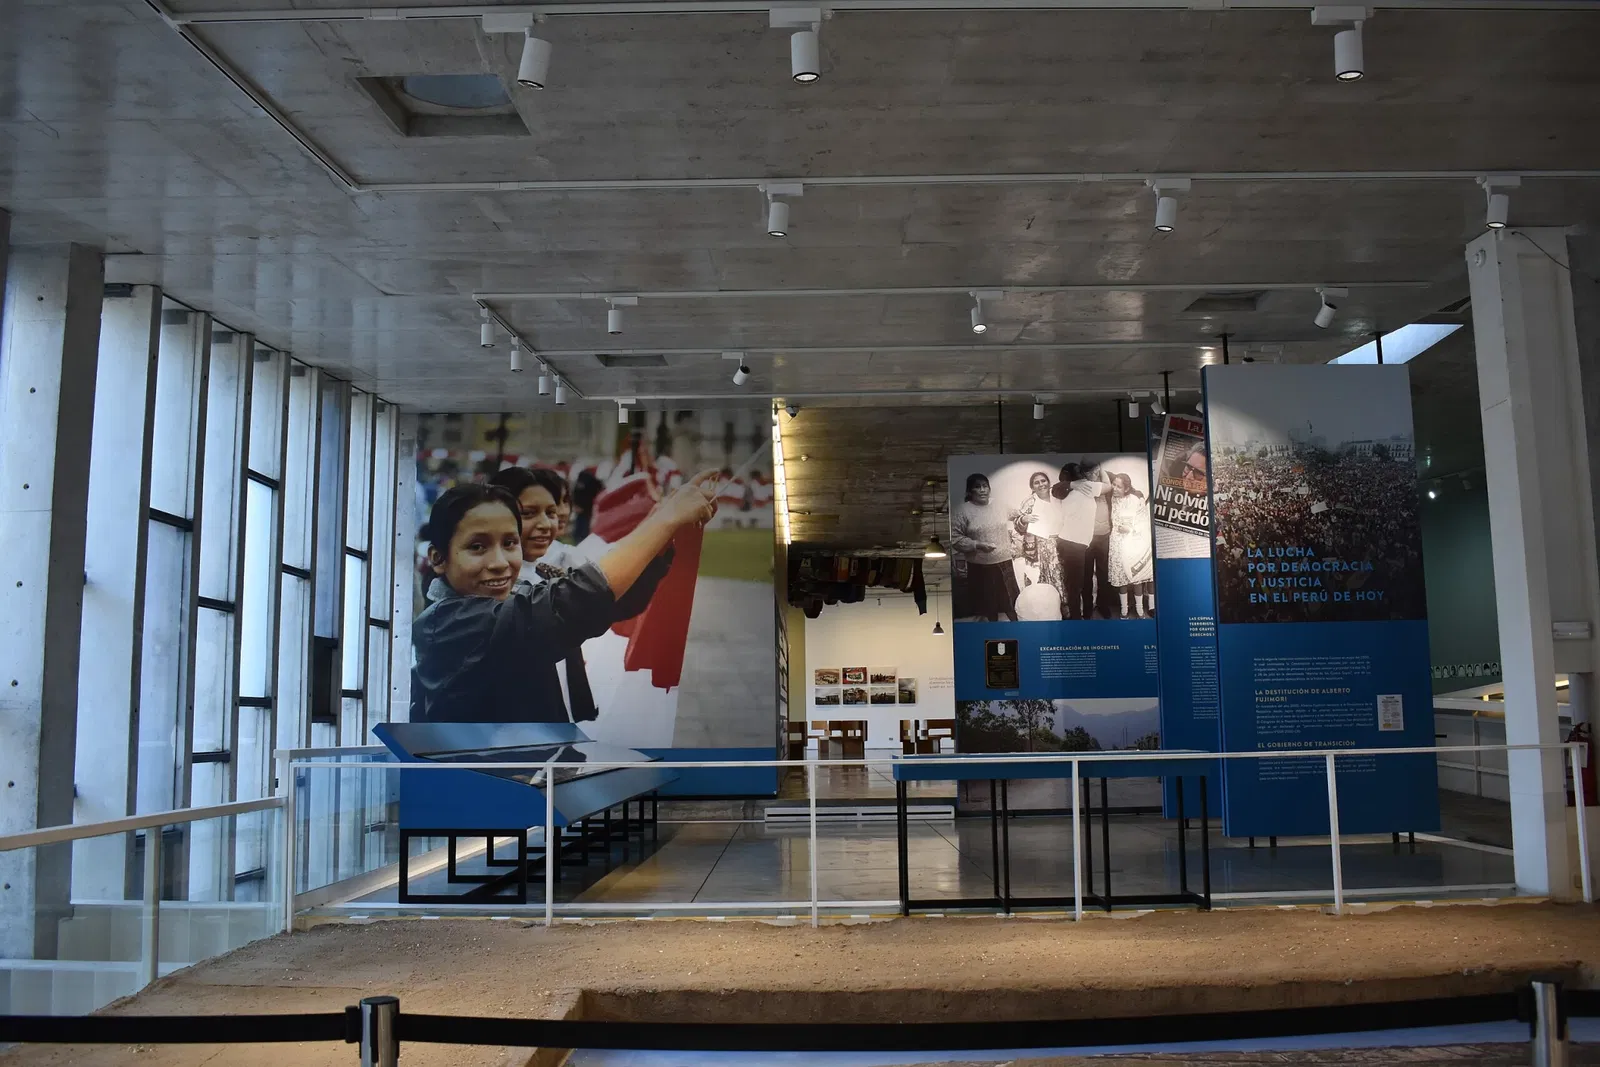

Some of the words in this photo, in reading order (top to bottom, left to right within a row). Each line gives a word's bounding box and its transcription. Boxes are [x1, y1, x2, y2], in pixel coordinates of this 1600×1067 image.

[1187, 421, 1200, 432] La
[1155, 484, 1174, 502] Ni
[1174, 491, 1209, 511] olvid
[1154, 502, 1168, 516] ni
[1167, 507, 1210, 527] perdó
[1247, 547, 1264, 558] LA
[1268, 546, 1315, 558] LUCHA
[1247, 562, 1276, 573] POR
[1281, 561, 1374, 572] DEMOCRACIA
[1248, 577, 1257, 588] Y
[1261, 576, 1323, 588] JUSTICIA
[1250, 592, 1268, 603] EN
[1273, 592, 1289, 603] EL
[1293, 589, 1329, 602] PERÚ
[1333, 591, 1351, 602] DE
[1356, 590, 1385, 601] HOY
[1265, 687, 1309, 696] DESTITUCIÓN
[1321, 687, 1351, 695] ALBERTO
[1304, 740, 1313, 748] DE
[1314, 739, 1356, 747] TRANSICIÓN
